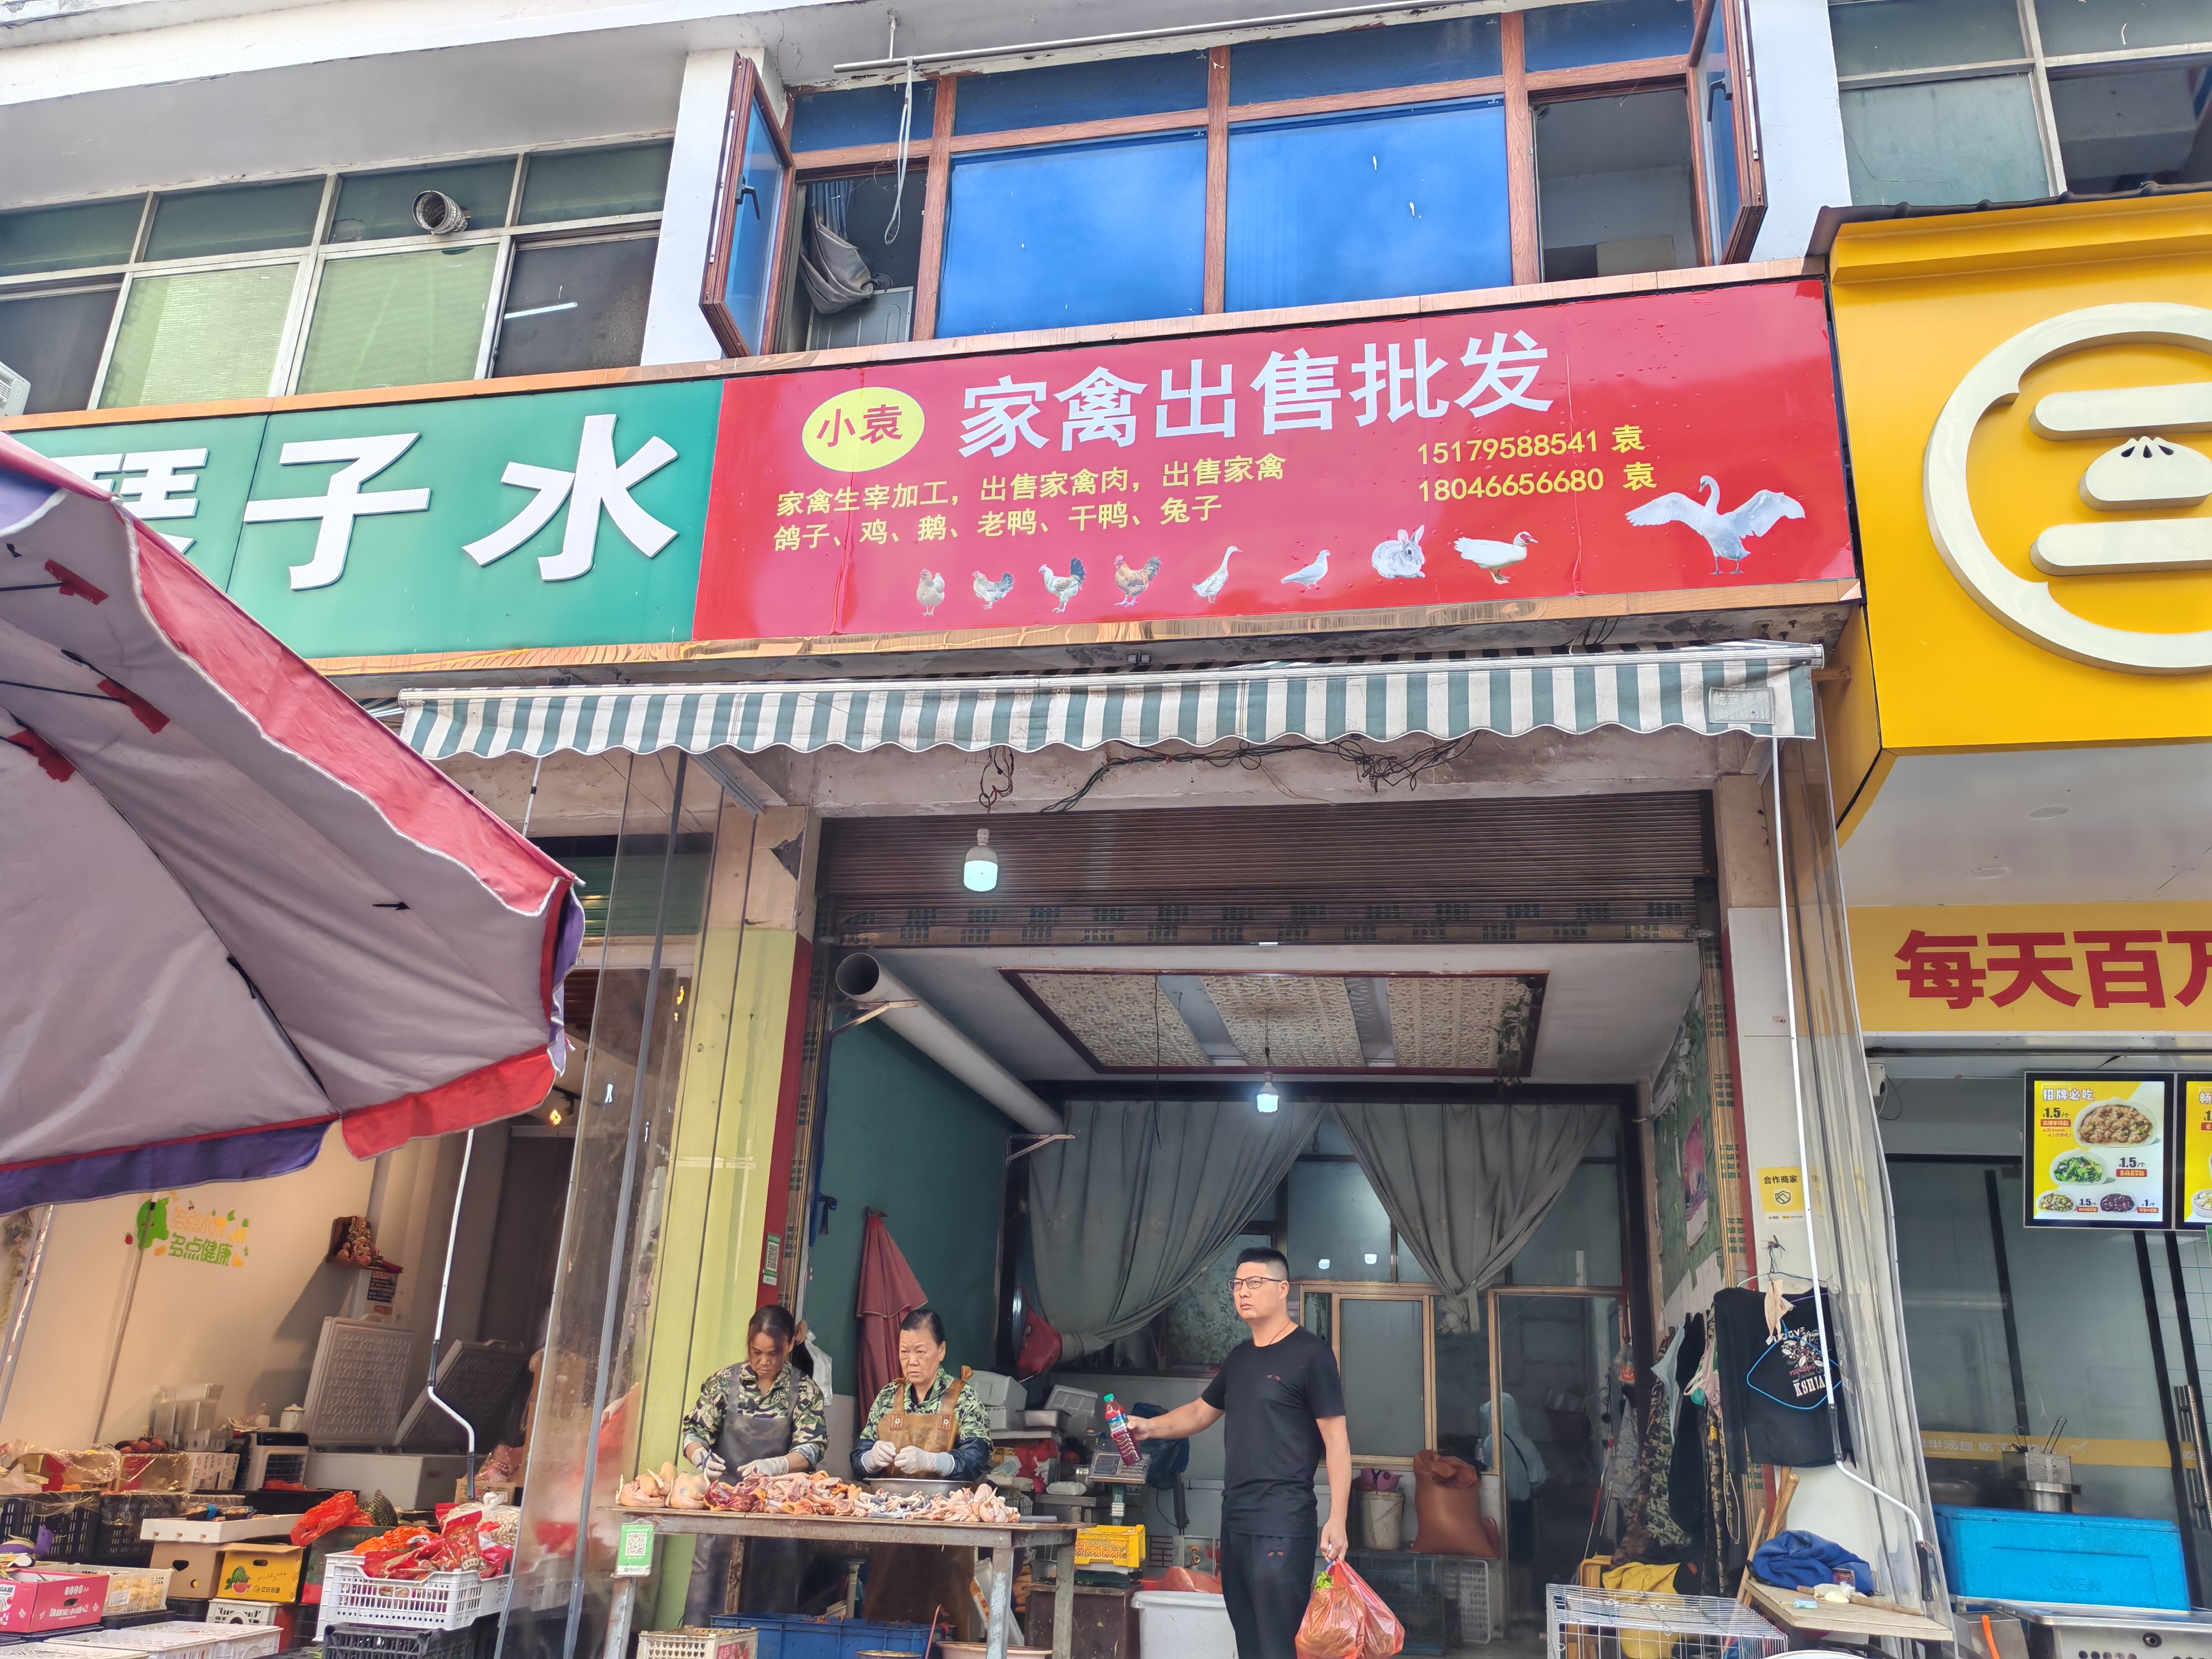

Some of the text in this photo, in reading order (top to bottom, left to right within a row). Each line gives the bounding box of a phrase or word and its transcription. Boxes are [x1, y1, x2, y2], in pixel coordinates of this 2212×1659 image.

[957, 329, 1554, 458] 家禽出售批发
[816, 403, 904, 448] 小袁
[1418, 424, 1645, 465] 15179588541 袁
[1419, 461, 1657, 502] 18046656680 袁
[2042, 1088, 2094, 1101] 招牌必吃
[1763, 1175, 1798, 1184] 合作商家
[168, 1232, 233, 1266] 多点健康
